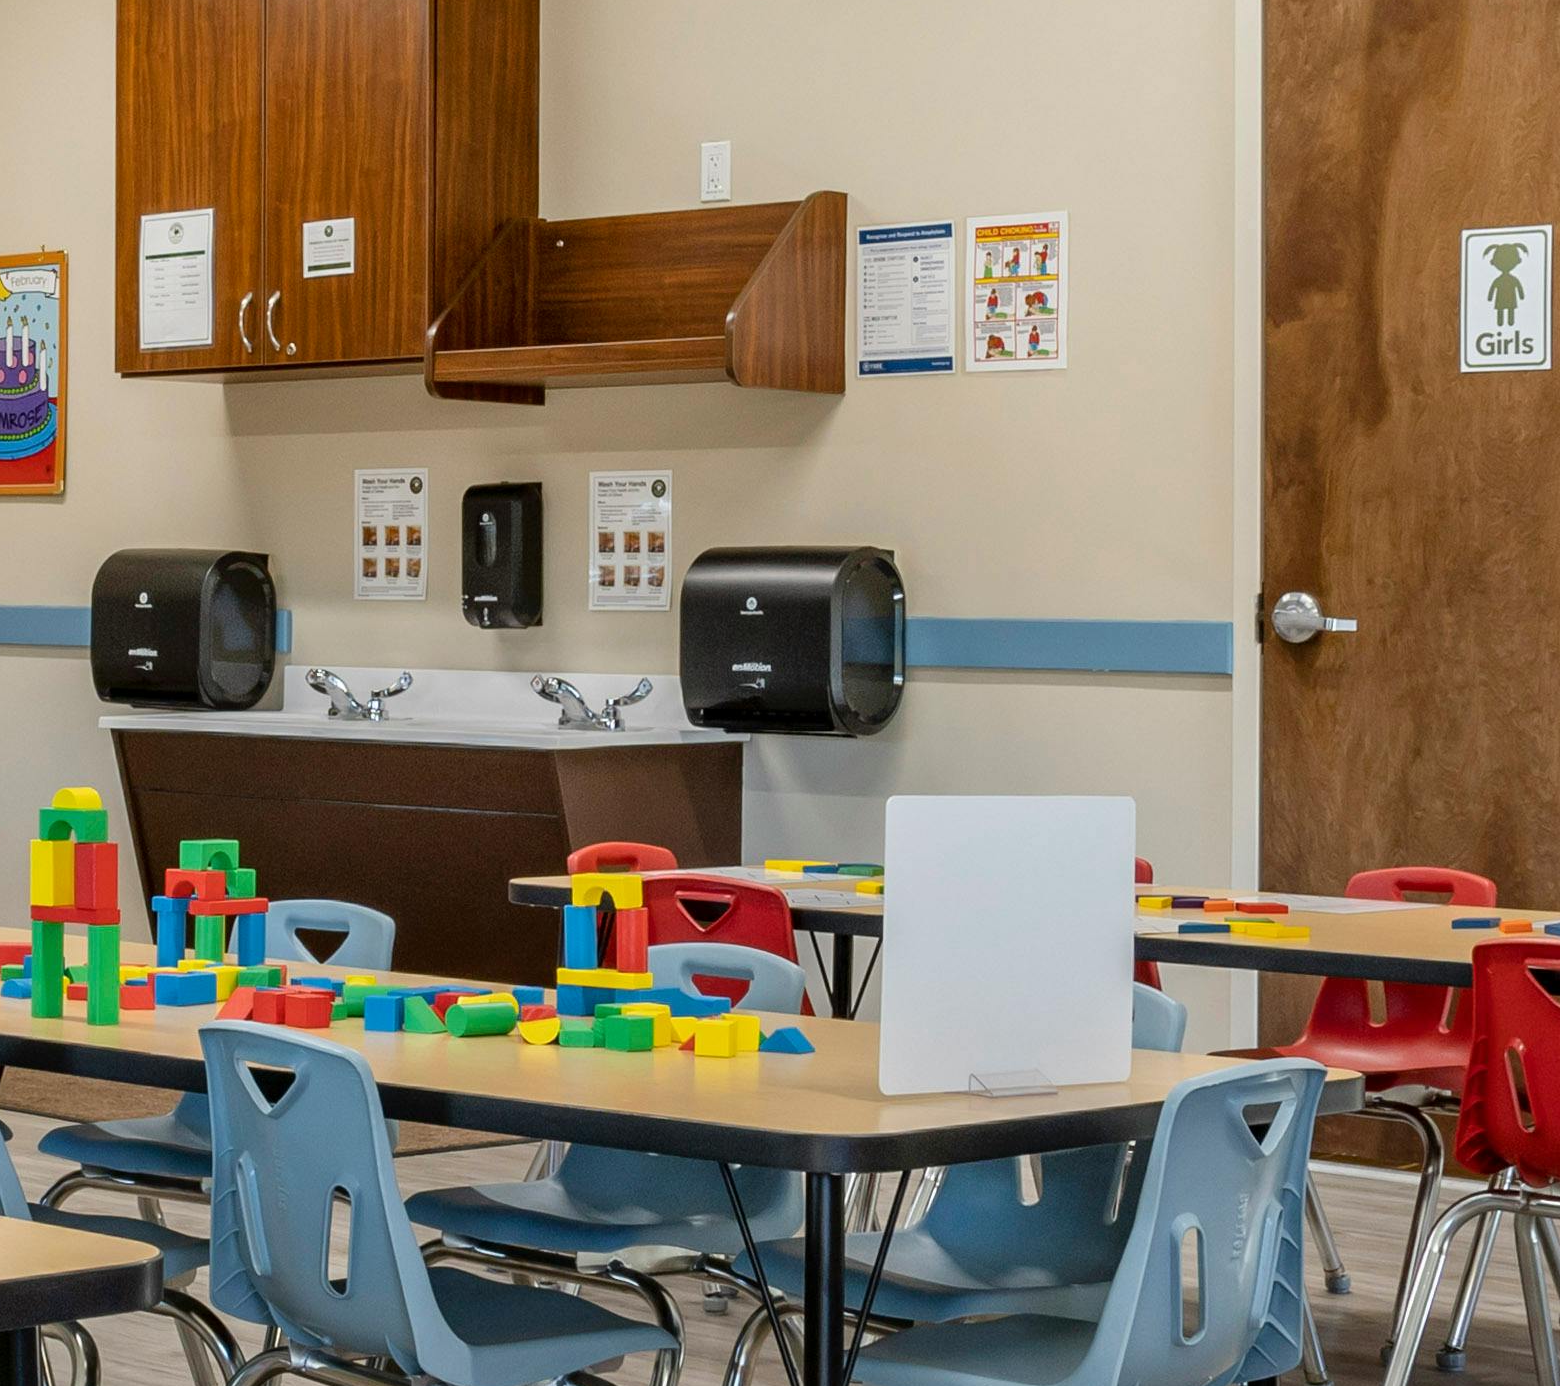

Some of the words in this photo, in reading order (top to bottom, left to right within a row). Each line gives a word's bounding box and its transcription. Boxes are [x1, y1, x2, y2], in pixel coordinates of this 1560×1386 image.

[10, 274, 47, 289] February
[1476, 330, 1534, 356] Girls
[732, 661, 772, 672] enMotion
